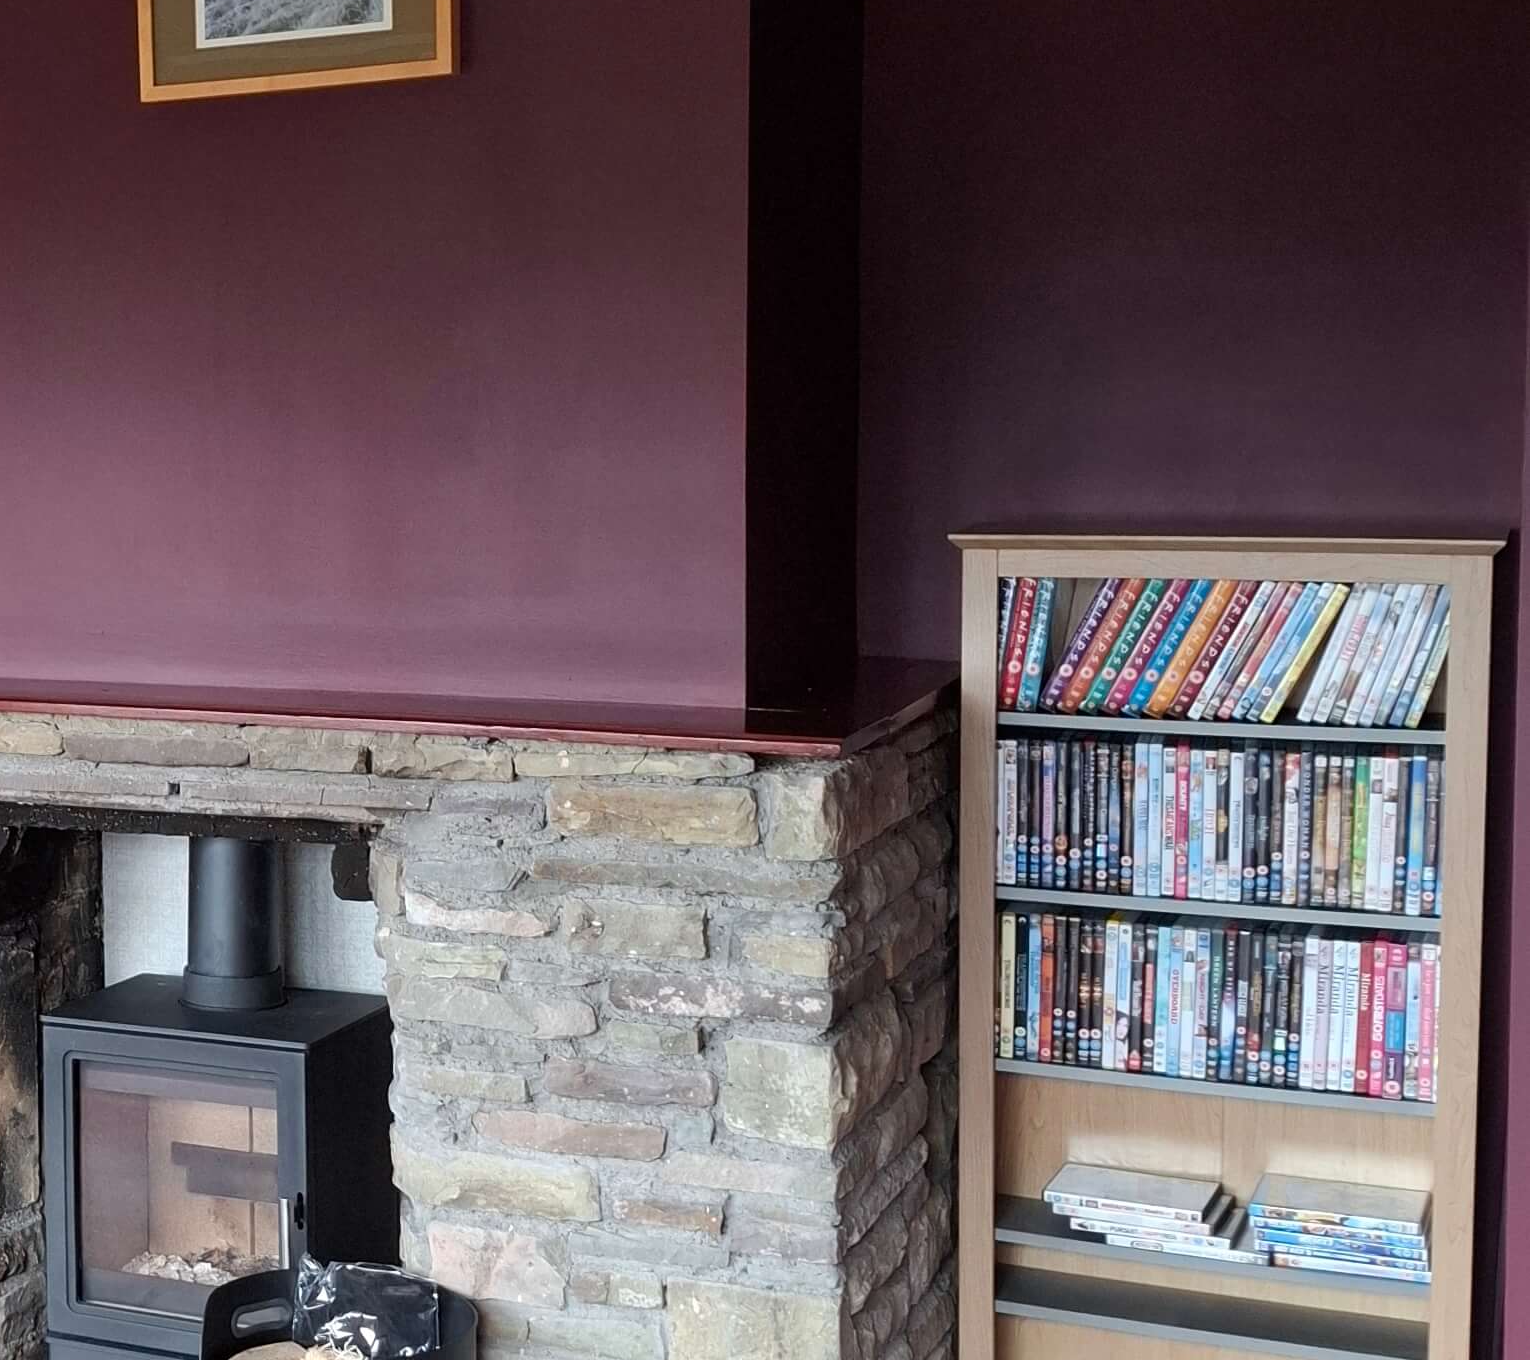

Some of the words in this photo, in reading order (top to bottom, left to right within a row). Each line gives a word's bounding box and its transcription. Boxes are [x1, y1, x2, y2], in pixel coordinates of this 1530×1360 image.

[1070, 589, 1115, 662] FRIENDS
[1113, 591, 1159, 665] FRIENDS
[1135, 591, 1181, 666] FRIENDS
[1201, 592, 1249, 669] FRIENDS
[1302, 763, 1311, 807] WONDER
[1301, 811, 1310, 849] WOMAN
[1171, 968, 1180, 1025] OVERBOARD
[1210, 987, 1219, 1027] LANTERN
